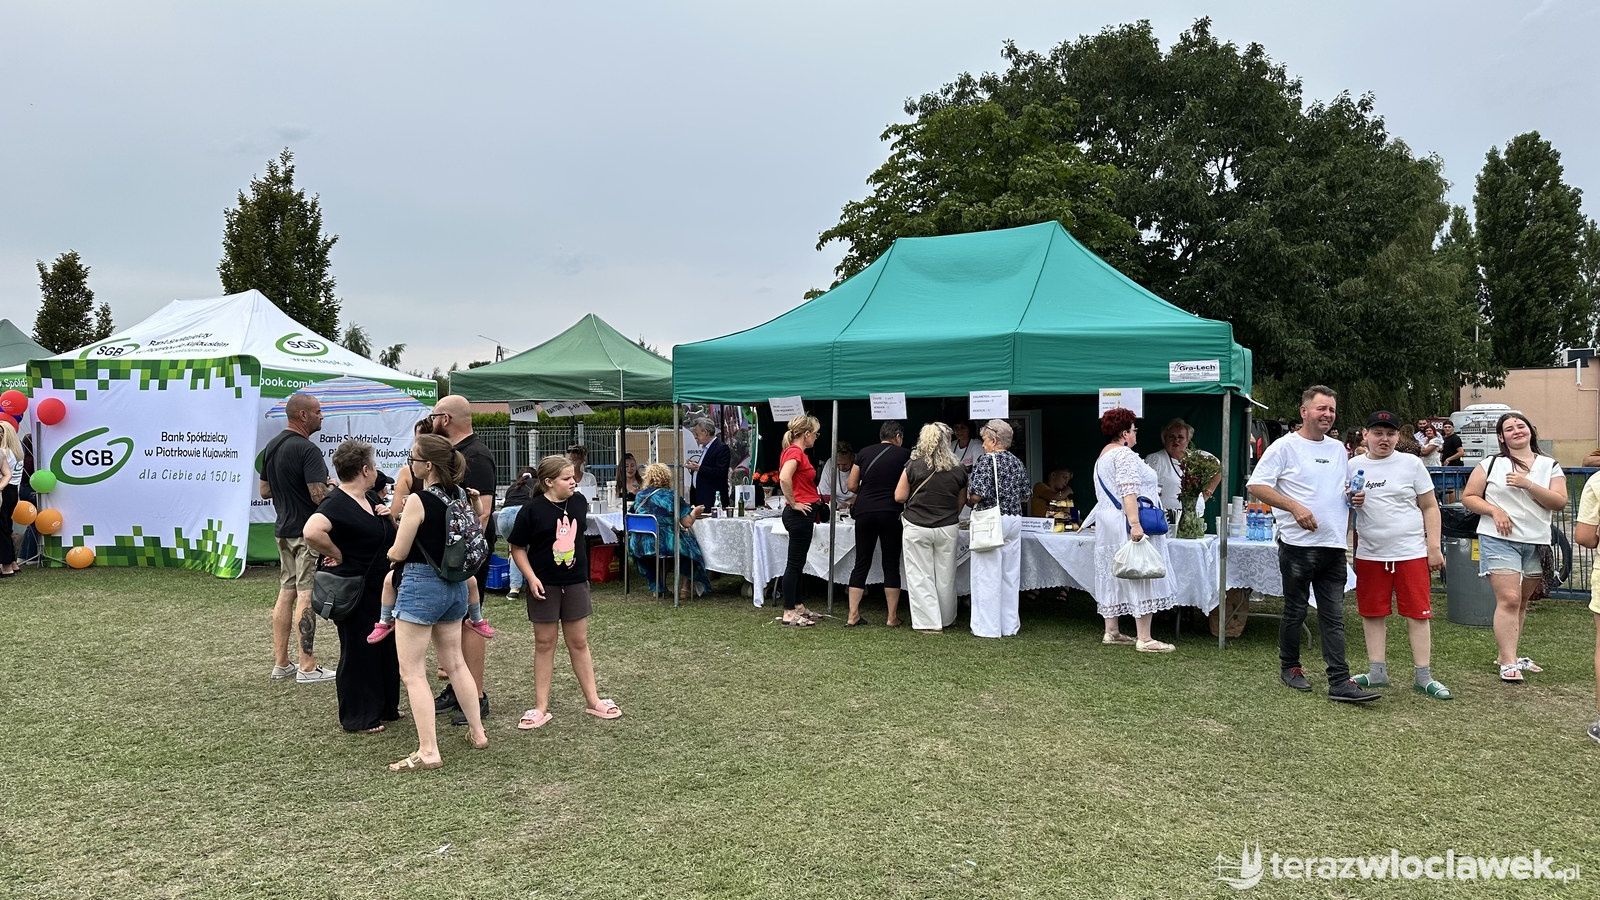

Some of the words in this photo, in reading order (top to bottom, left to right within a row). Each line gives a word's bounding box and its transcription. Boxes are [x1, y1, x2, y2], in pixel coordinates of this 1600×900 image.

[96, 345, 124, 357] SGB
[286, 340, 321, 350] SGB
[511, 404, 534, 415] LOTERIA
[161, 431, 185, 442] Bank
[186, 431, 228, 445] Spółdzielczy
[319, 433, 343, 443] Bank
[71, 449, 114, 467] SGB
[144, 449, 154, 457] w
[156, 446, 201, 458] Piotrkowie
[202, 447, 239, 460] Kujawskim
[138, 468, 157, 480] dla
[161, 468, 193, 481] Ciebie
[195, 470, 207, 481] od
[210, 470, 228, 482] 150
[229, 471, 241, 483] lat
